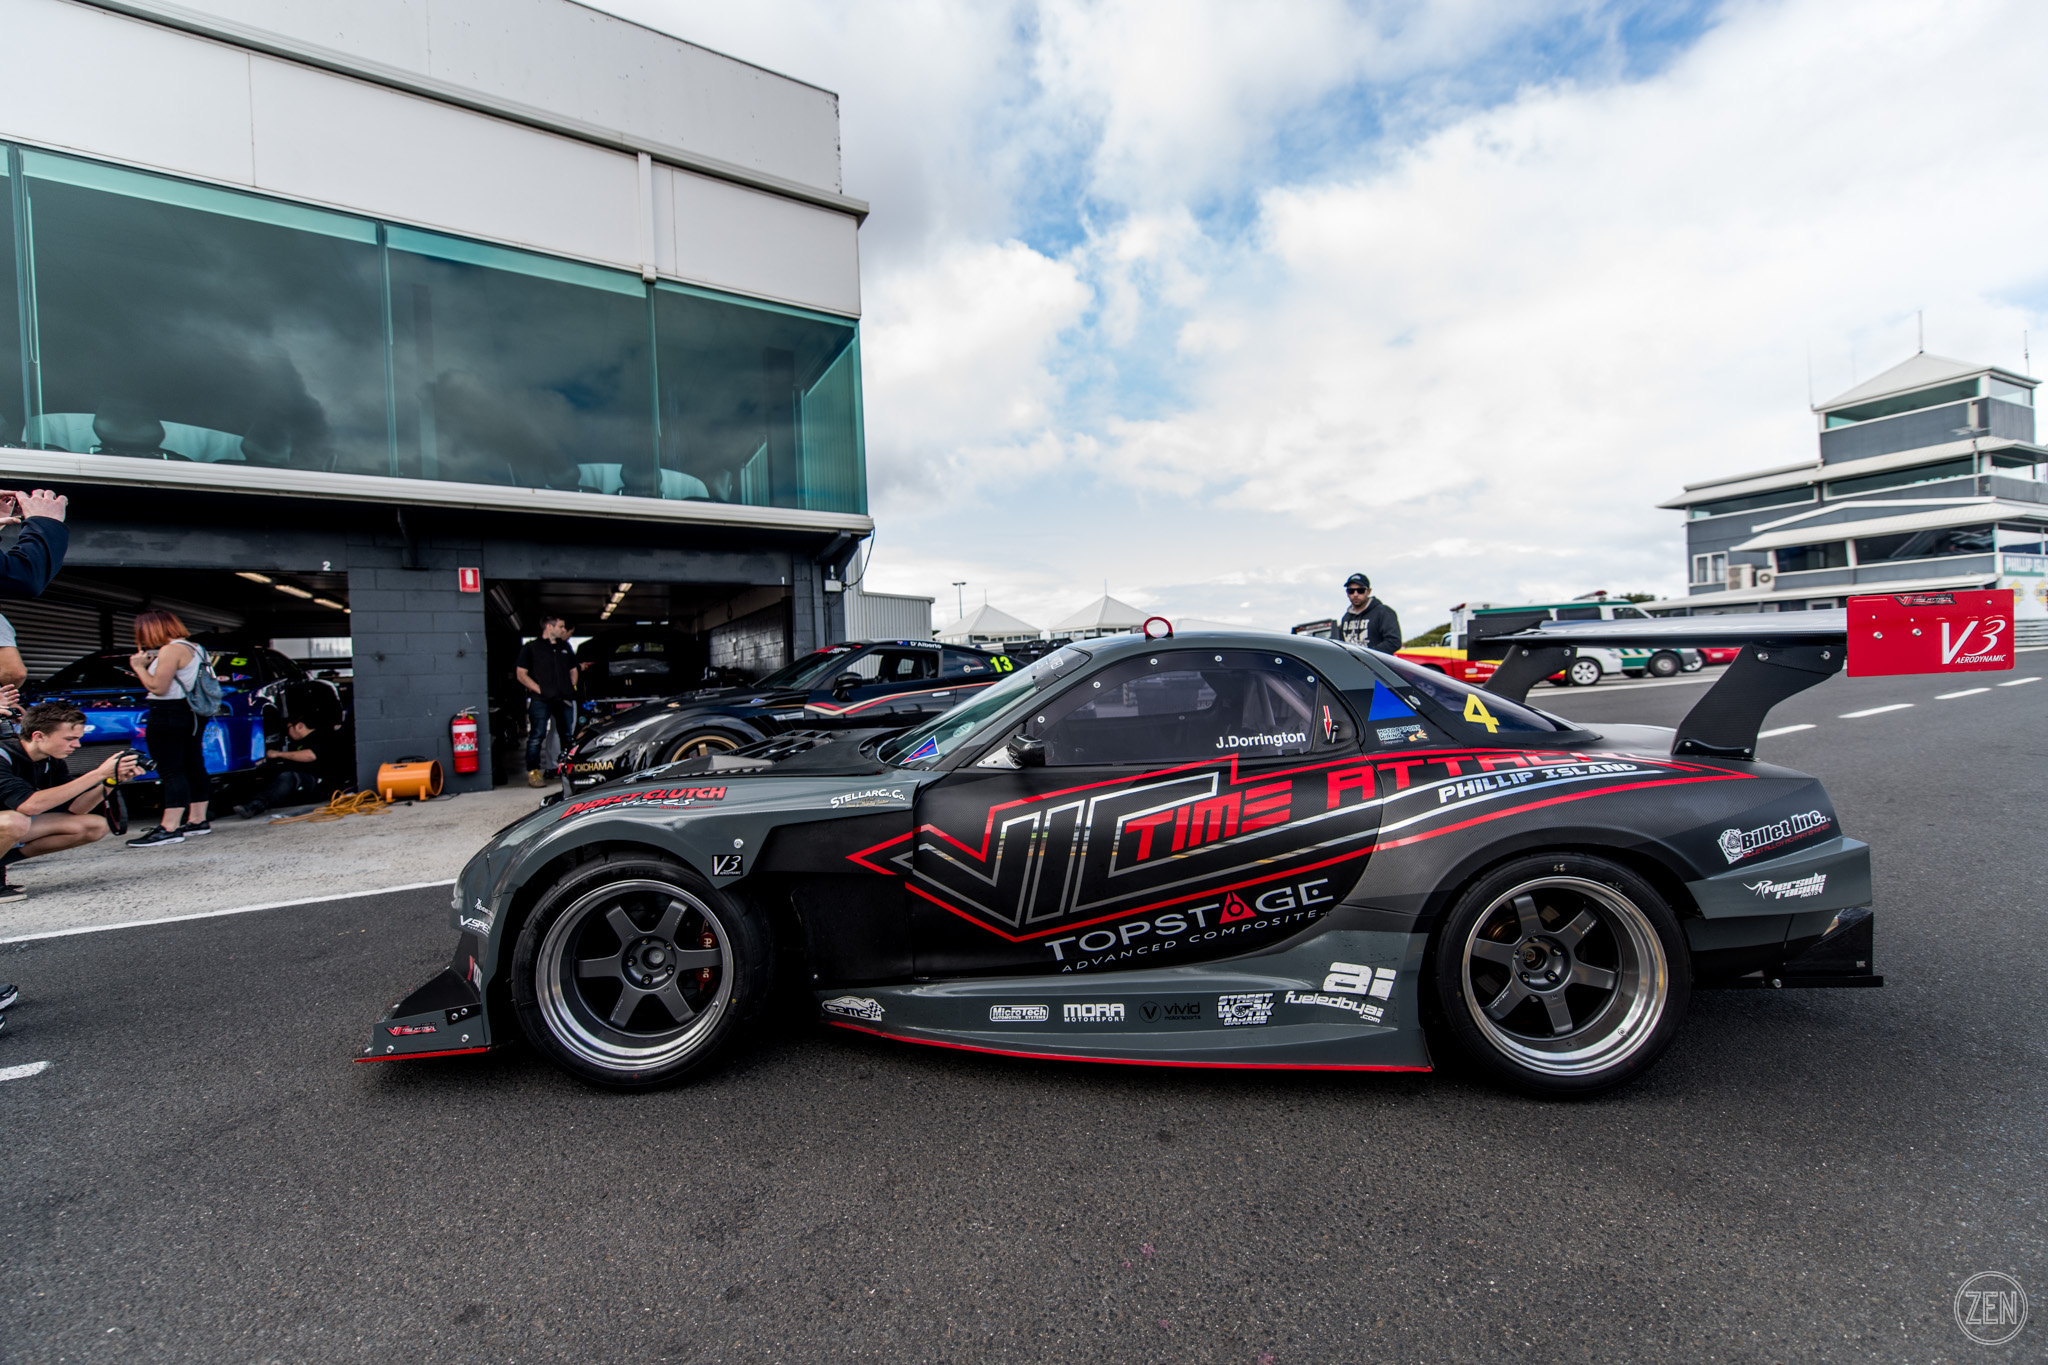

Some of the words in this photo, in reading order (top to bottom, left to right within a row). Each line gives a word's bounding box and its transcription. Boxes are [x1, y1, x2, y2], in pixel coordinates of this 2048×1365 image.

[322, 561, 331, 571] 2
[1941, 619, 2006, 665] V3
[230, 657, 248, 666] 5
[990, 656, 1013, 673] 13
[1955, 655, 2006, 664] AERODYNAMIC
[1463, 693, 1500, 734] 4
[1215, 732, 1307, 749] J.Dorrington
[574, 761, 615, 772] YOKOHAMA
[1438, 771, 1534, 804] PHILLIP
[1545, 763, 1638, 780] ISLAND
[559, 791, 644, 820] DIRECT
[641, 786, 728, 801] CLUTCH
[1124, 780, 1292, 862] TIME
[1740, 824, 1792, 852] Billet
[1791, 810, 1827, 834] Inc.
[1764, 839, 1785, 851] ALLOY
[713, 855, 742, 875] V3
[1045, 878, 1334, 961] TOPSTAGE
[1062, 940, 1177, 973] ADVANCED
[1323, 961, 1397, 1001] ai
[1164, 1002, 1200, 1015] vivid
[1217, 993, 1274, 1006] STREET
[1284, 990, 1385, 1018] fueledbyai
[992, 1006, 1047, 1017] MicroTech
[1063, 1003, 1125, 1017] MORA
